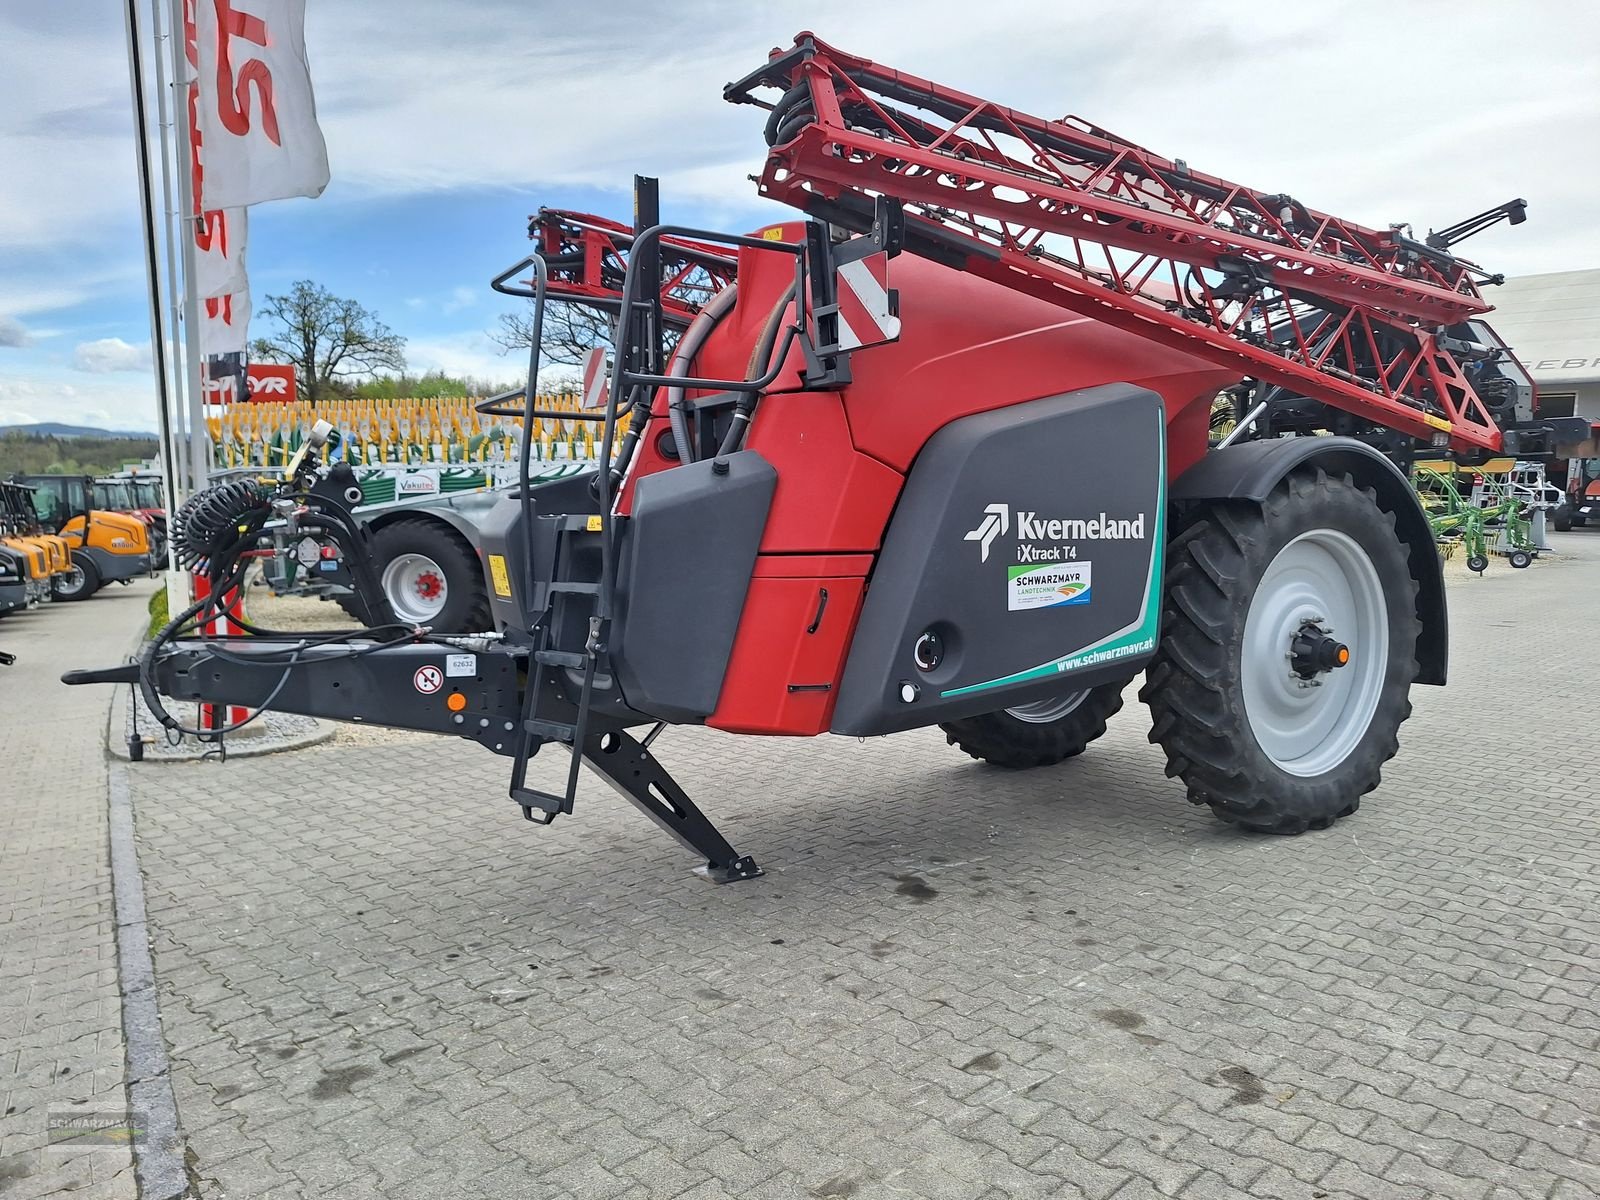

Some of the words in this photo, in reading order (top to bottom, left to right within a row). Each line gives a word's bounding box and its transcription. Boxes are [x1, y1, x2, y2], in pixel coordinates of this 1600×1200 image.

[1017, 511, 1145, 540] Kverneland
[1017, 544, 1060, 562] iXtrack
[1063, 546, 1077, 559] T4
[1016, 573, 1081, 587] SCHWARZMAYR
[1017, 586, 1056, 595] LANDTECHNIK
[1057, 637, 1153, 672] www.schwarzmayr.at
[453, 660, 473, 668] 62632
